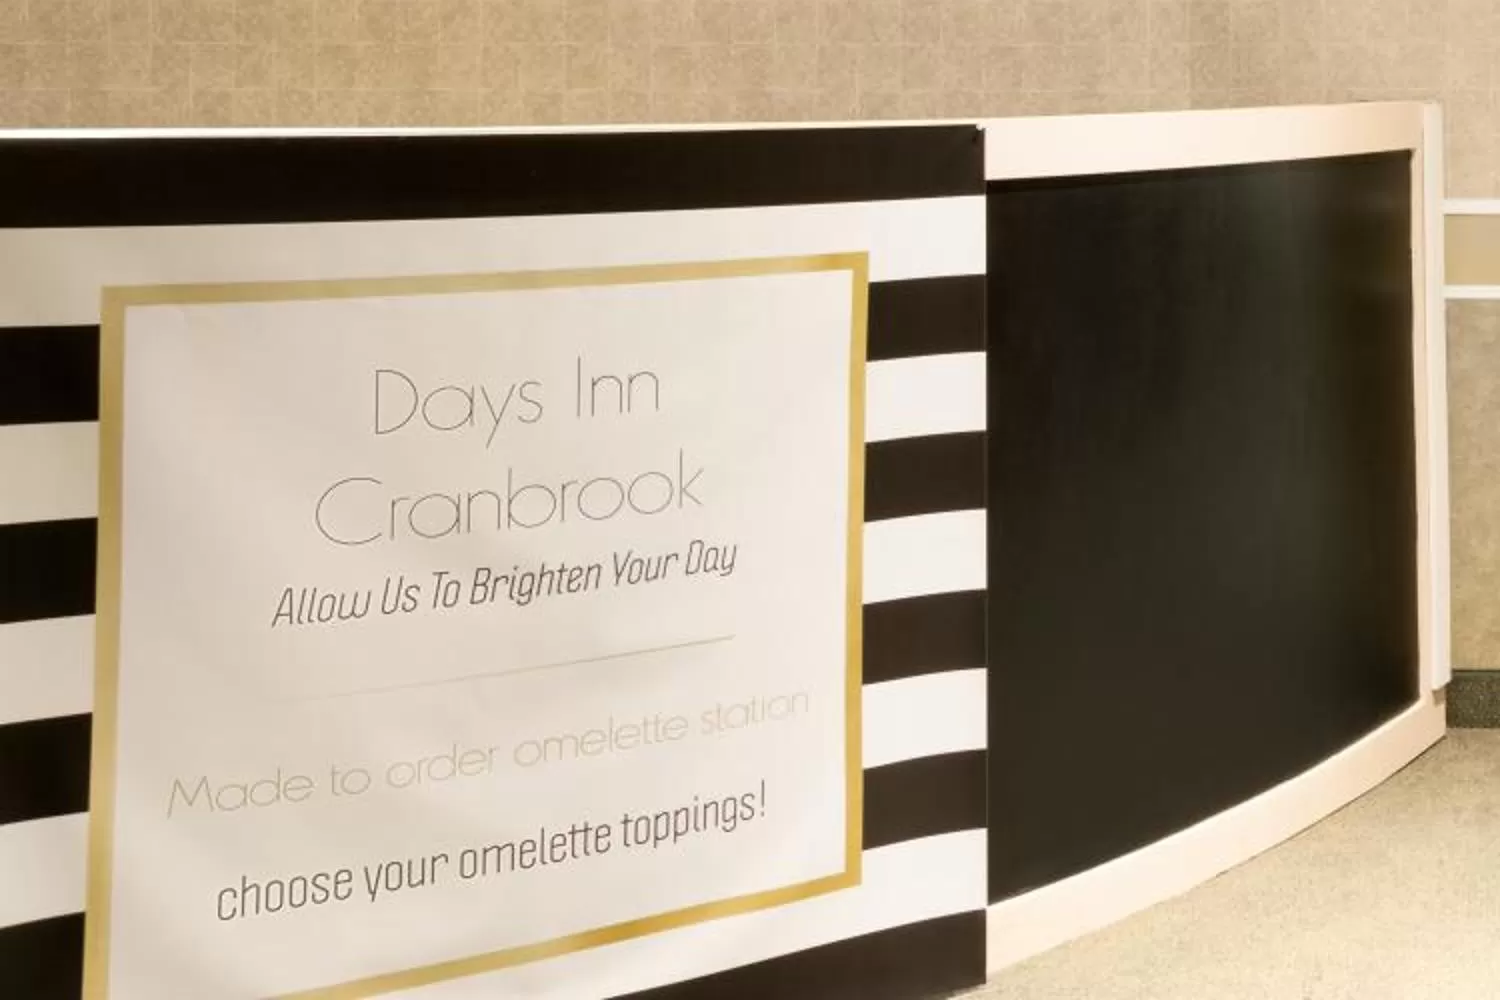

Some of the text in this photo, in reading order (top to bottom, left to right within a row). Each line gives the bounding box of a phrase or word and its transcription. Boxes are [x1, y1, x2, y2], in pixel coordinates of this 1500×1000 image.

[375, 356, 659, 448] Days Inn
[315, 448, 704, 545] Cranbrook
[271, 539, 738, 628] Allow Us To Brighten Your Day
[166, 689, 810, 818] Made to order omelette station
[216, 781, 768, 921] choose your omelette toppings!
